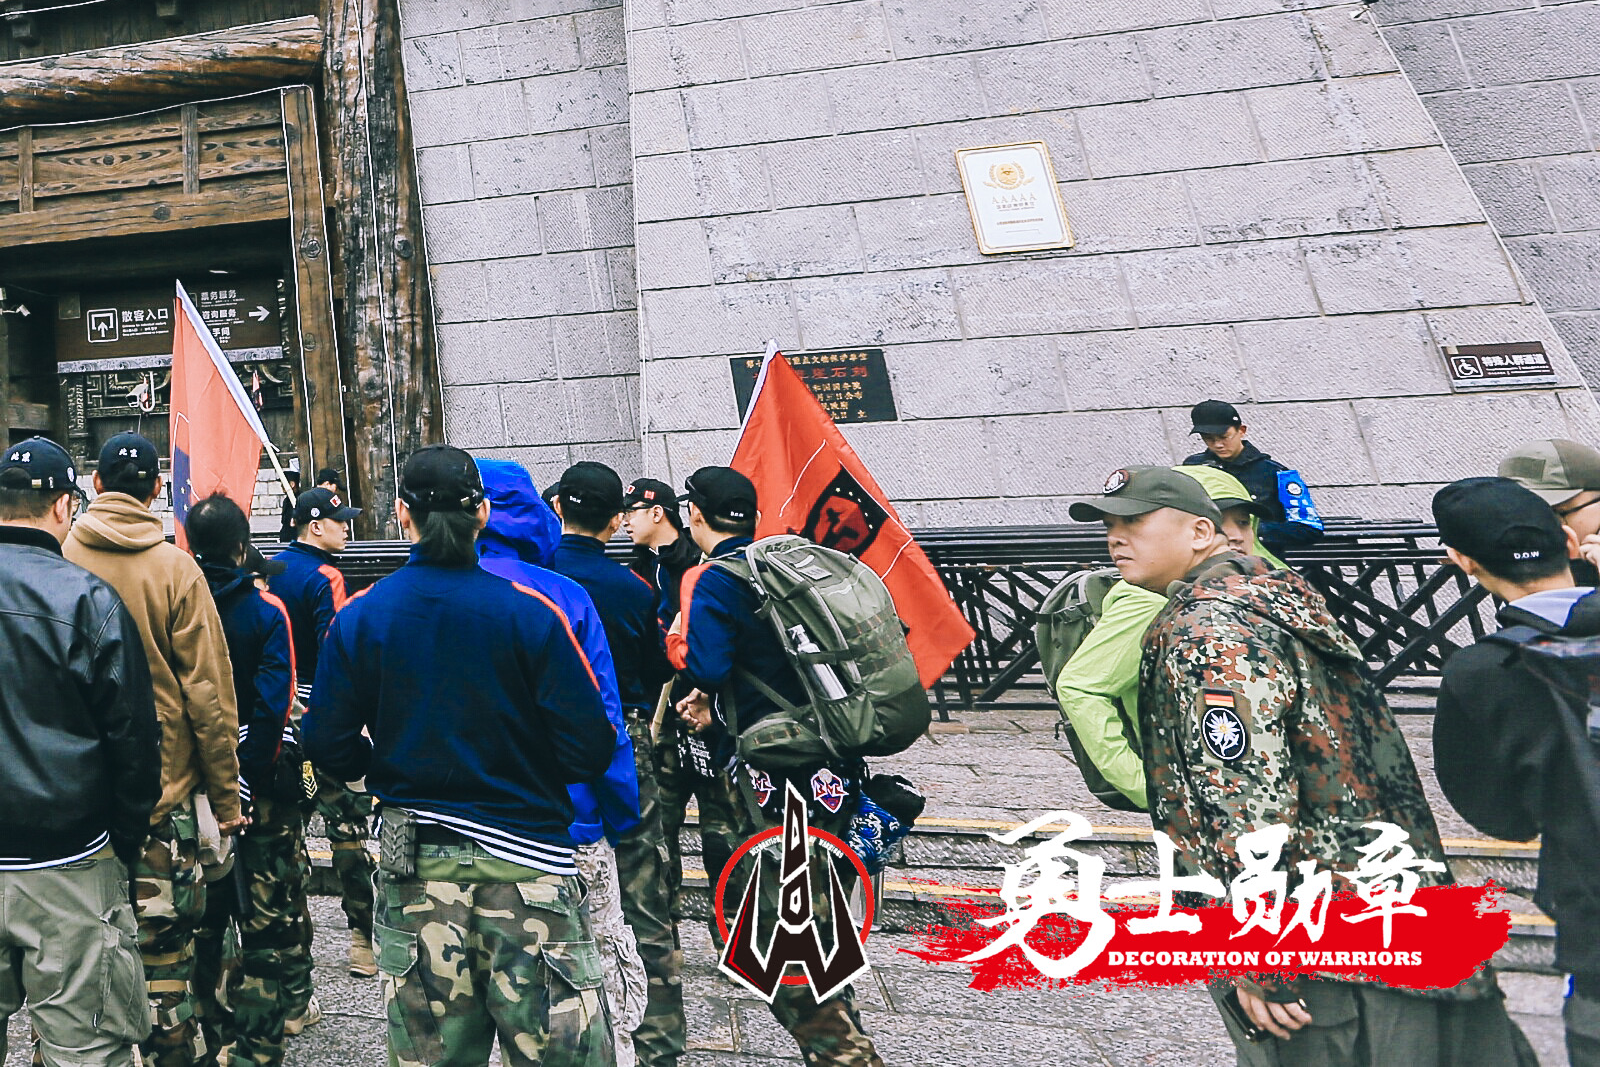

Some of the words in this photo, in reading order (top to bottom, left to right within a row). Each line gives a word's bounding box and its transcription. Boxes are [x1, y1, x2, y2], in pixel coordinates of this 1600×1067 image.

[121, 308, 169, 323] 散客入口
[211, 326, 231, 337] 手间
